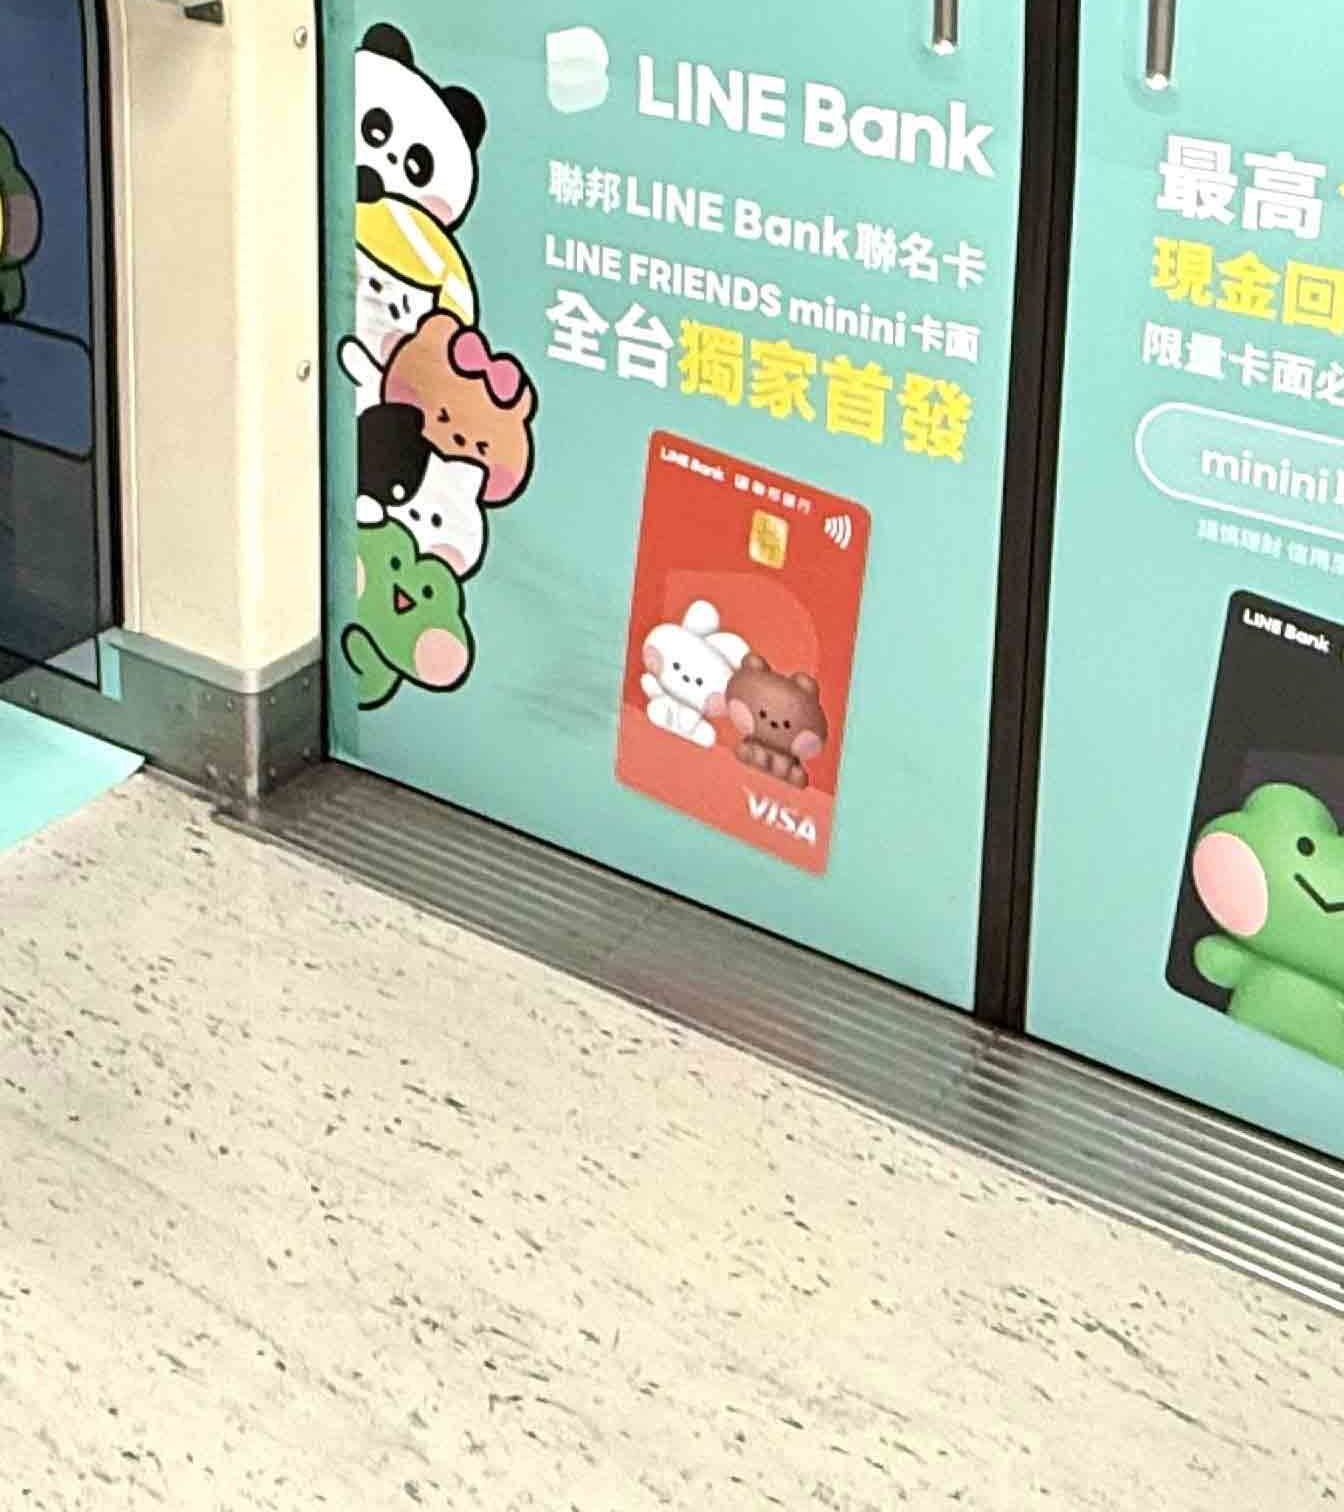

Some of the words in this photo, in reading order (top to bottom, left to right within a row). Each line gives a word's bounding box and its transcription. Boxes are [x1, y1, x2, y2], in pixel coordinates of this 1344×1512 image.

[638, 55, 786, 140] LINE
[803, 81, 994, 178] Bank
[1155, 133, 1326, 240] 最高
[544, 234, 622, 281] LINE
[628, 252, 783, 318] FRIENDS
[788, 293, 907, 349] minini
[911, 314, 981, 365] 卡面
[544, 288, 973, 465] 全台獨家首發
[1199, 446, 1330, 505] minini
[1242, 607, 1284, 636] LINE
[1283, 622, 1332, 654] Bank
[745, 793, 817, 847] VISA
